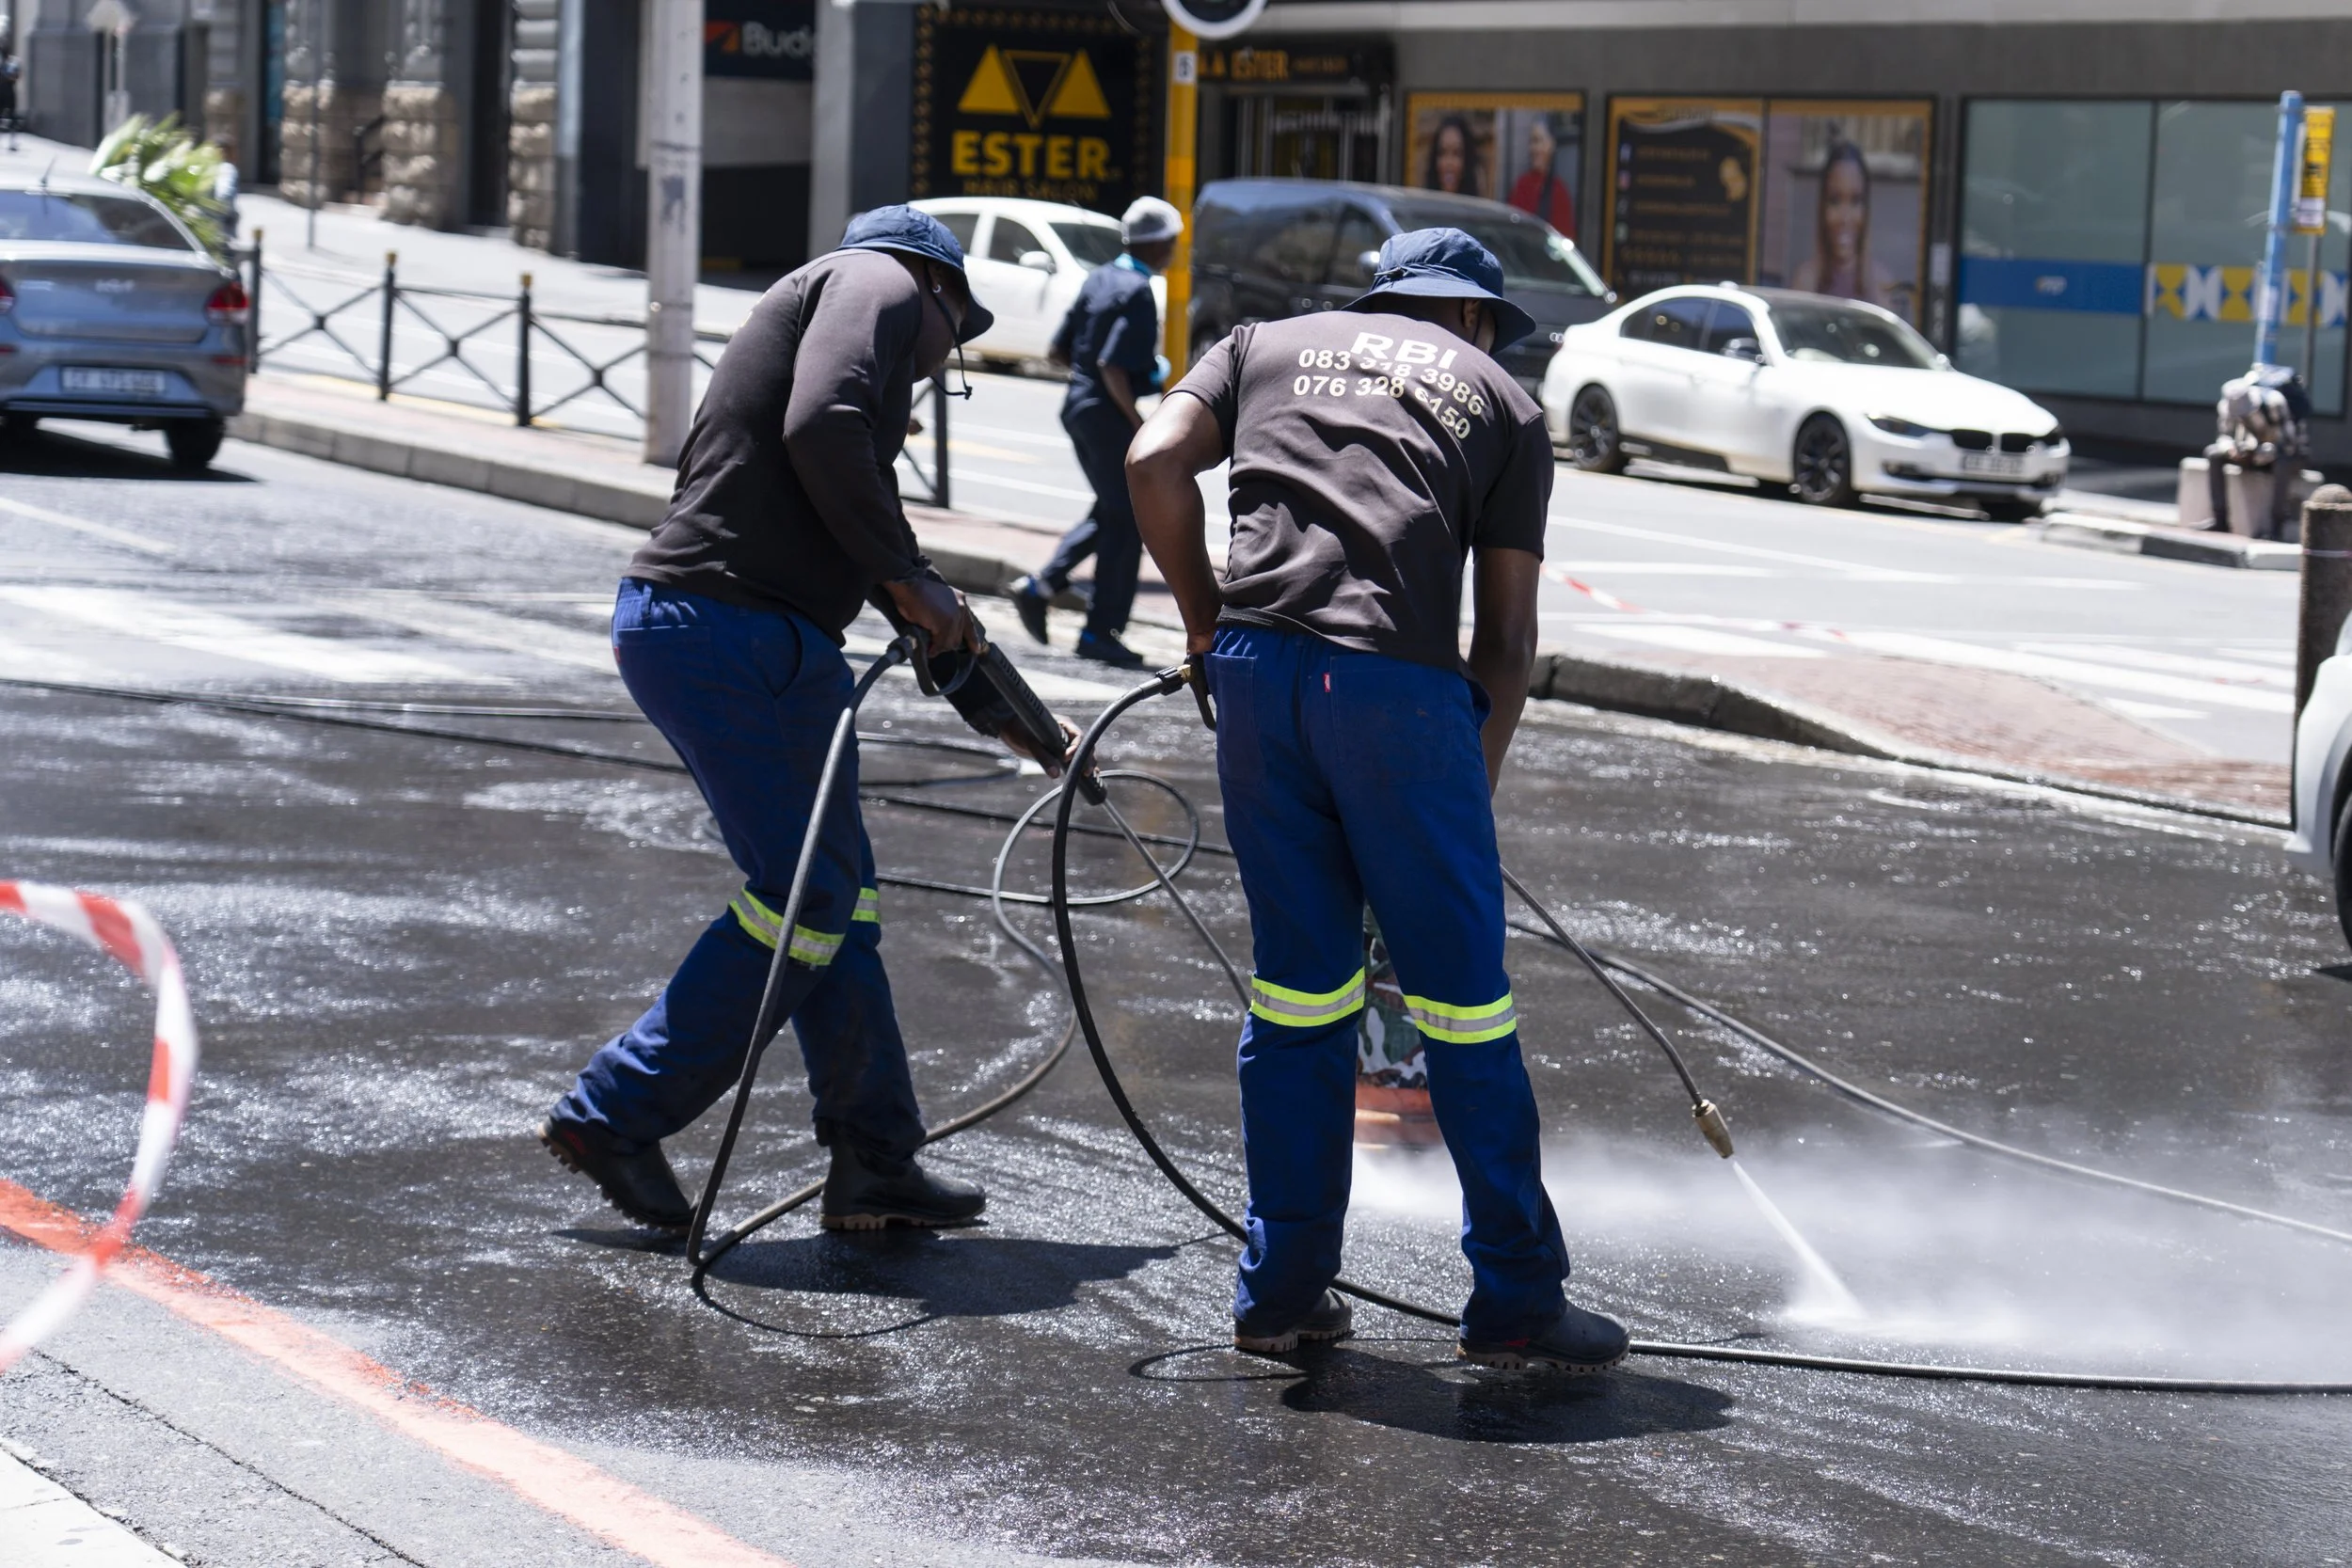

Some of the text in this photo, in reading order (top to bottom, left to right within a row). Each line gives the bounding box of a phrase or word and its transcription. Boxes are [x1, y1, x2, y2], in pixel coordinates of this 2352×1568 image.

[741, 21, 815, 59] Bud
[951, 130, 1110, 182] ESTER
[1350, 331, 1457, 370] RBI
[1294, 375, 1346, 397] 076
[1355, 376, 1406, 398] 328
[1298, 349, 1485, 416] 083 318 3986
